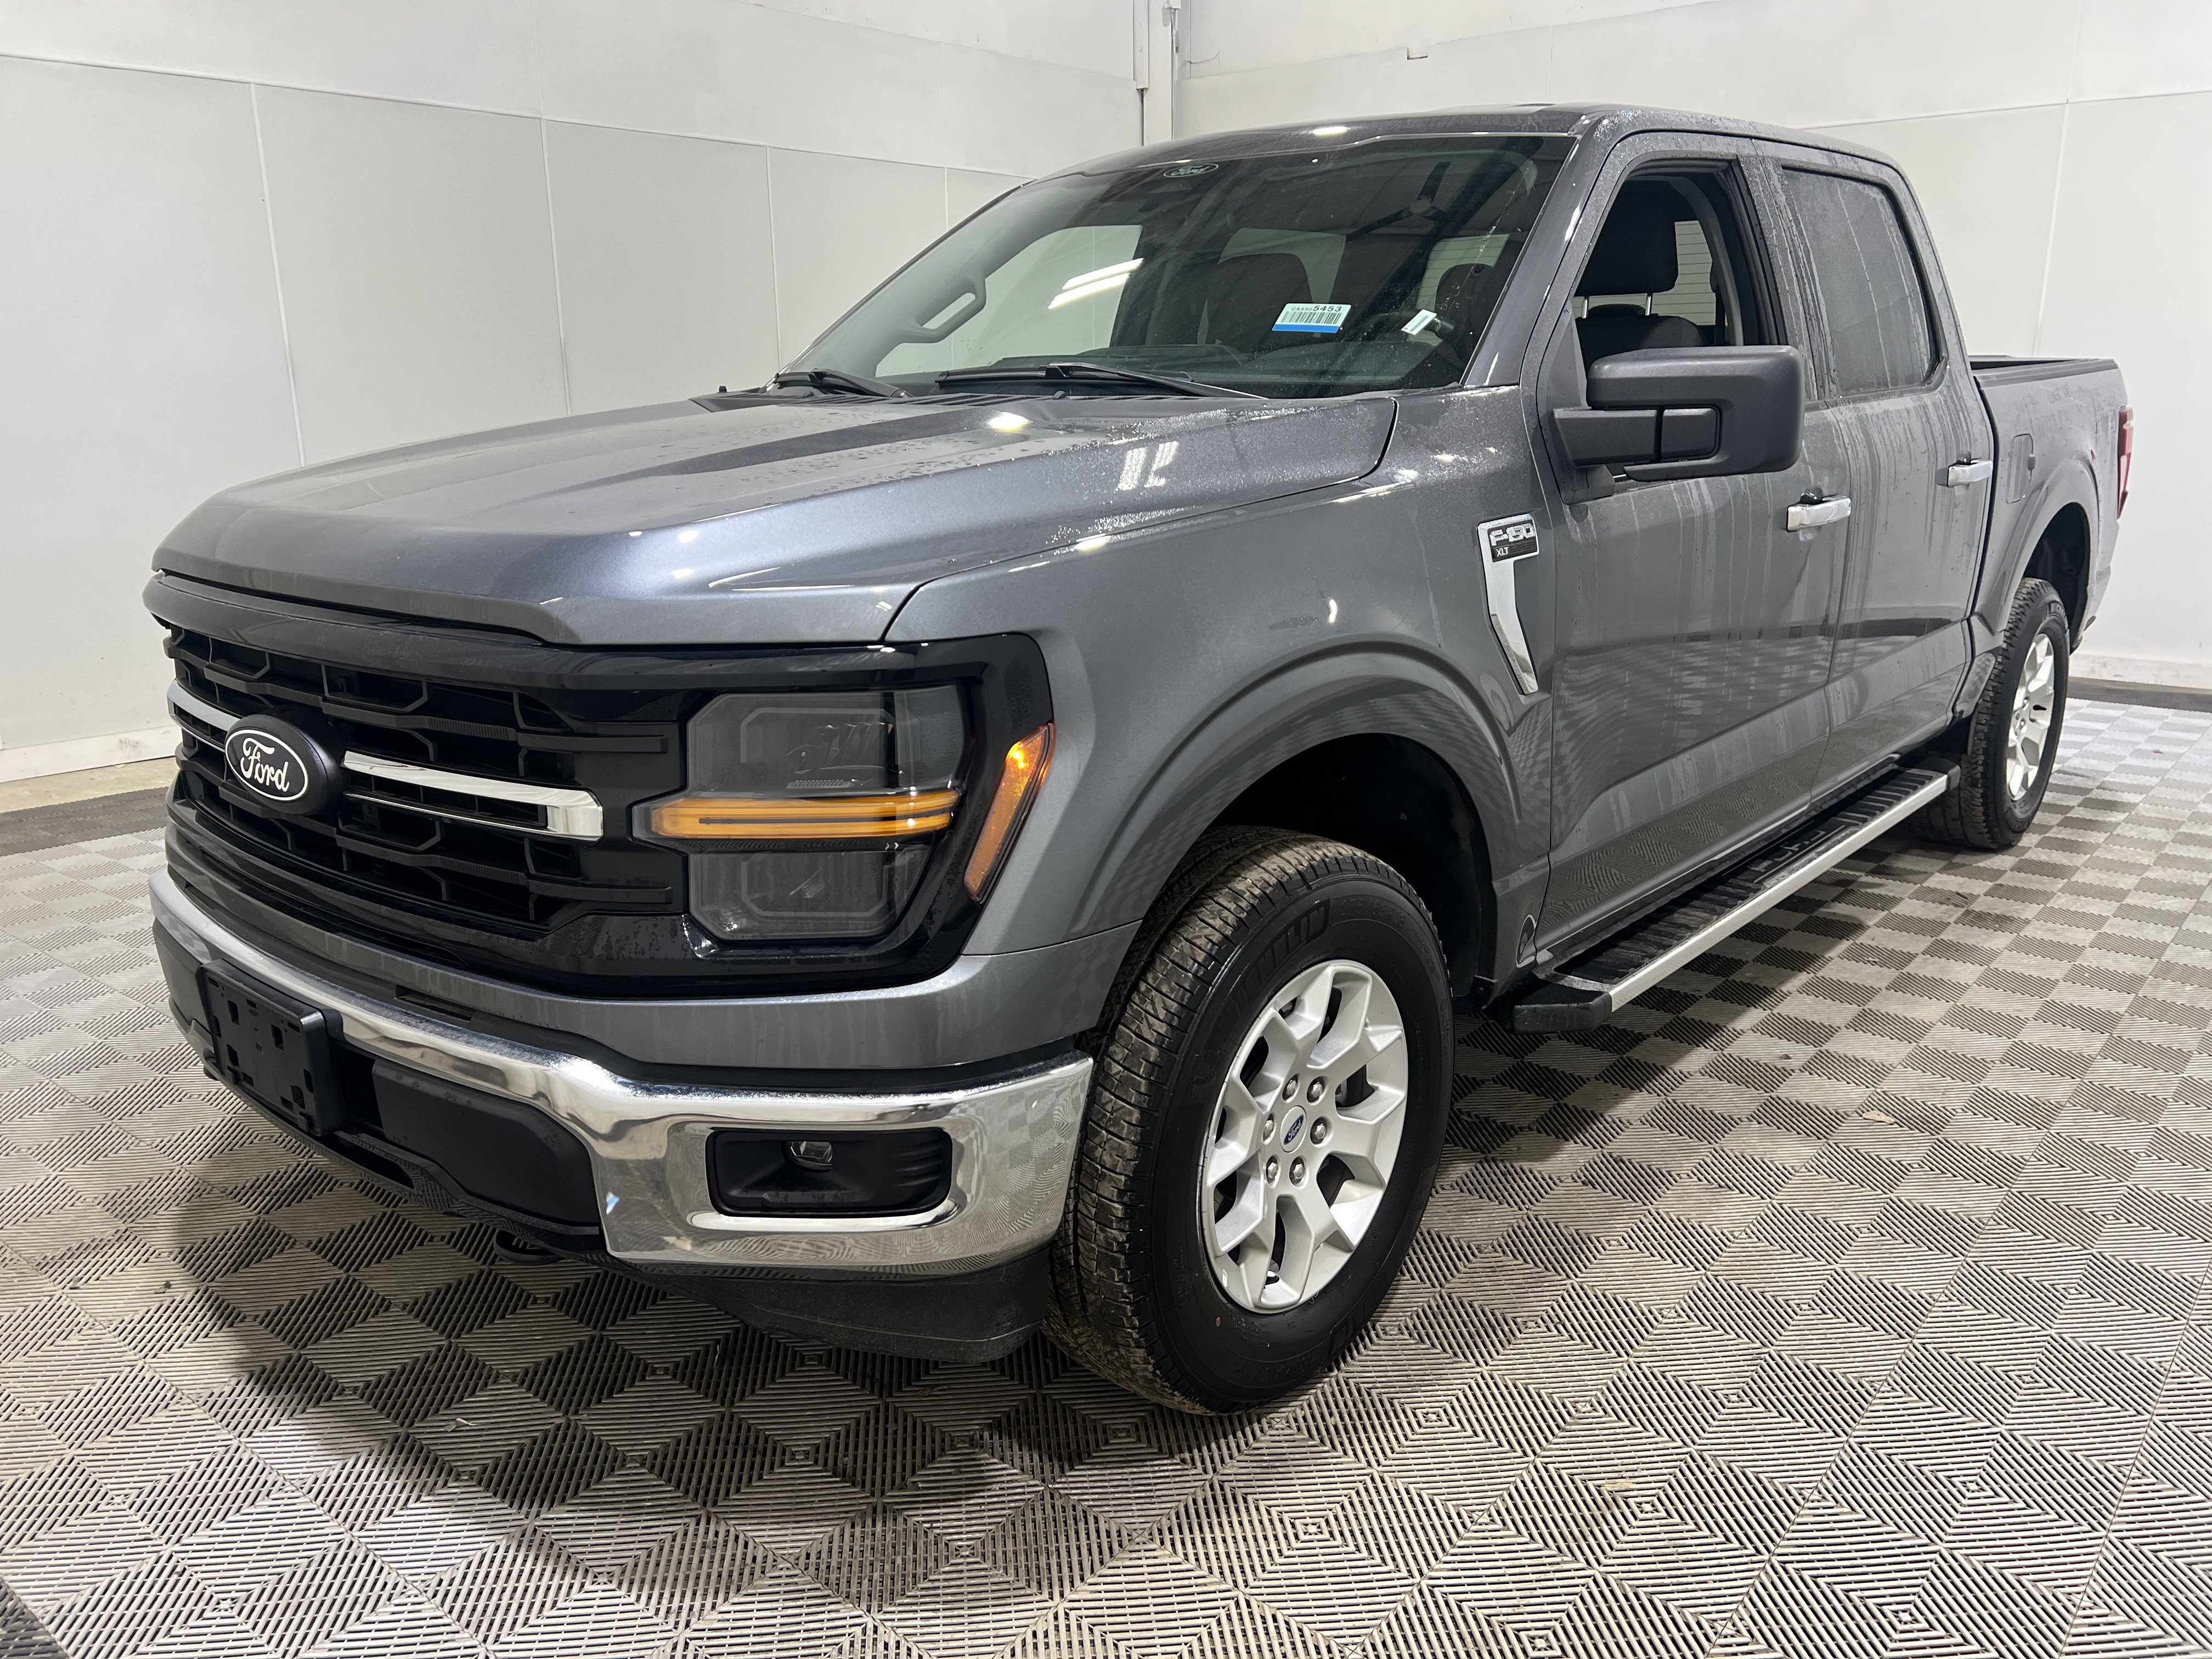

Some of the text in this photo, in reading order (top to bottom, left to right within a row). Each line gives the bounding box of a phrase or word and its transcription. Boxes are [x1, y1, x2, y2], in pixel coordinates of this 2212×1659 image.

[1171, 165, 1211, 176] Ford
[1489, 522, 1536, 546] F-150
[1496, 546, 1509, 557] XLT
[240, 737, 290, 792] Ford
[1218, 906, 1326, 1037] MICHELIN
[1288, 1119, 1302, 1141] Ford
